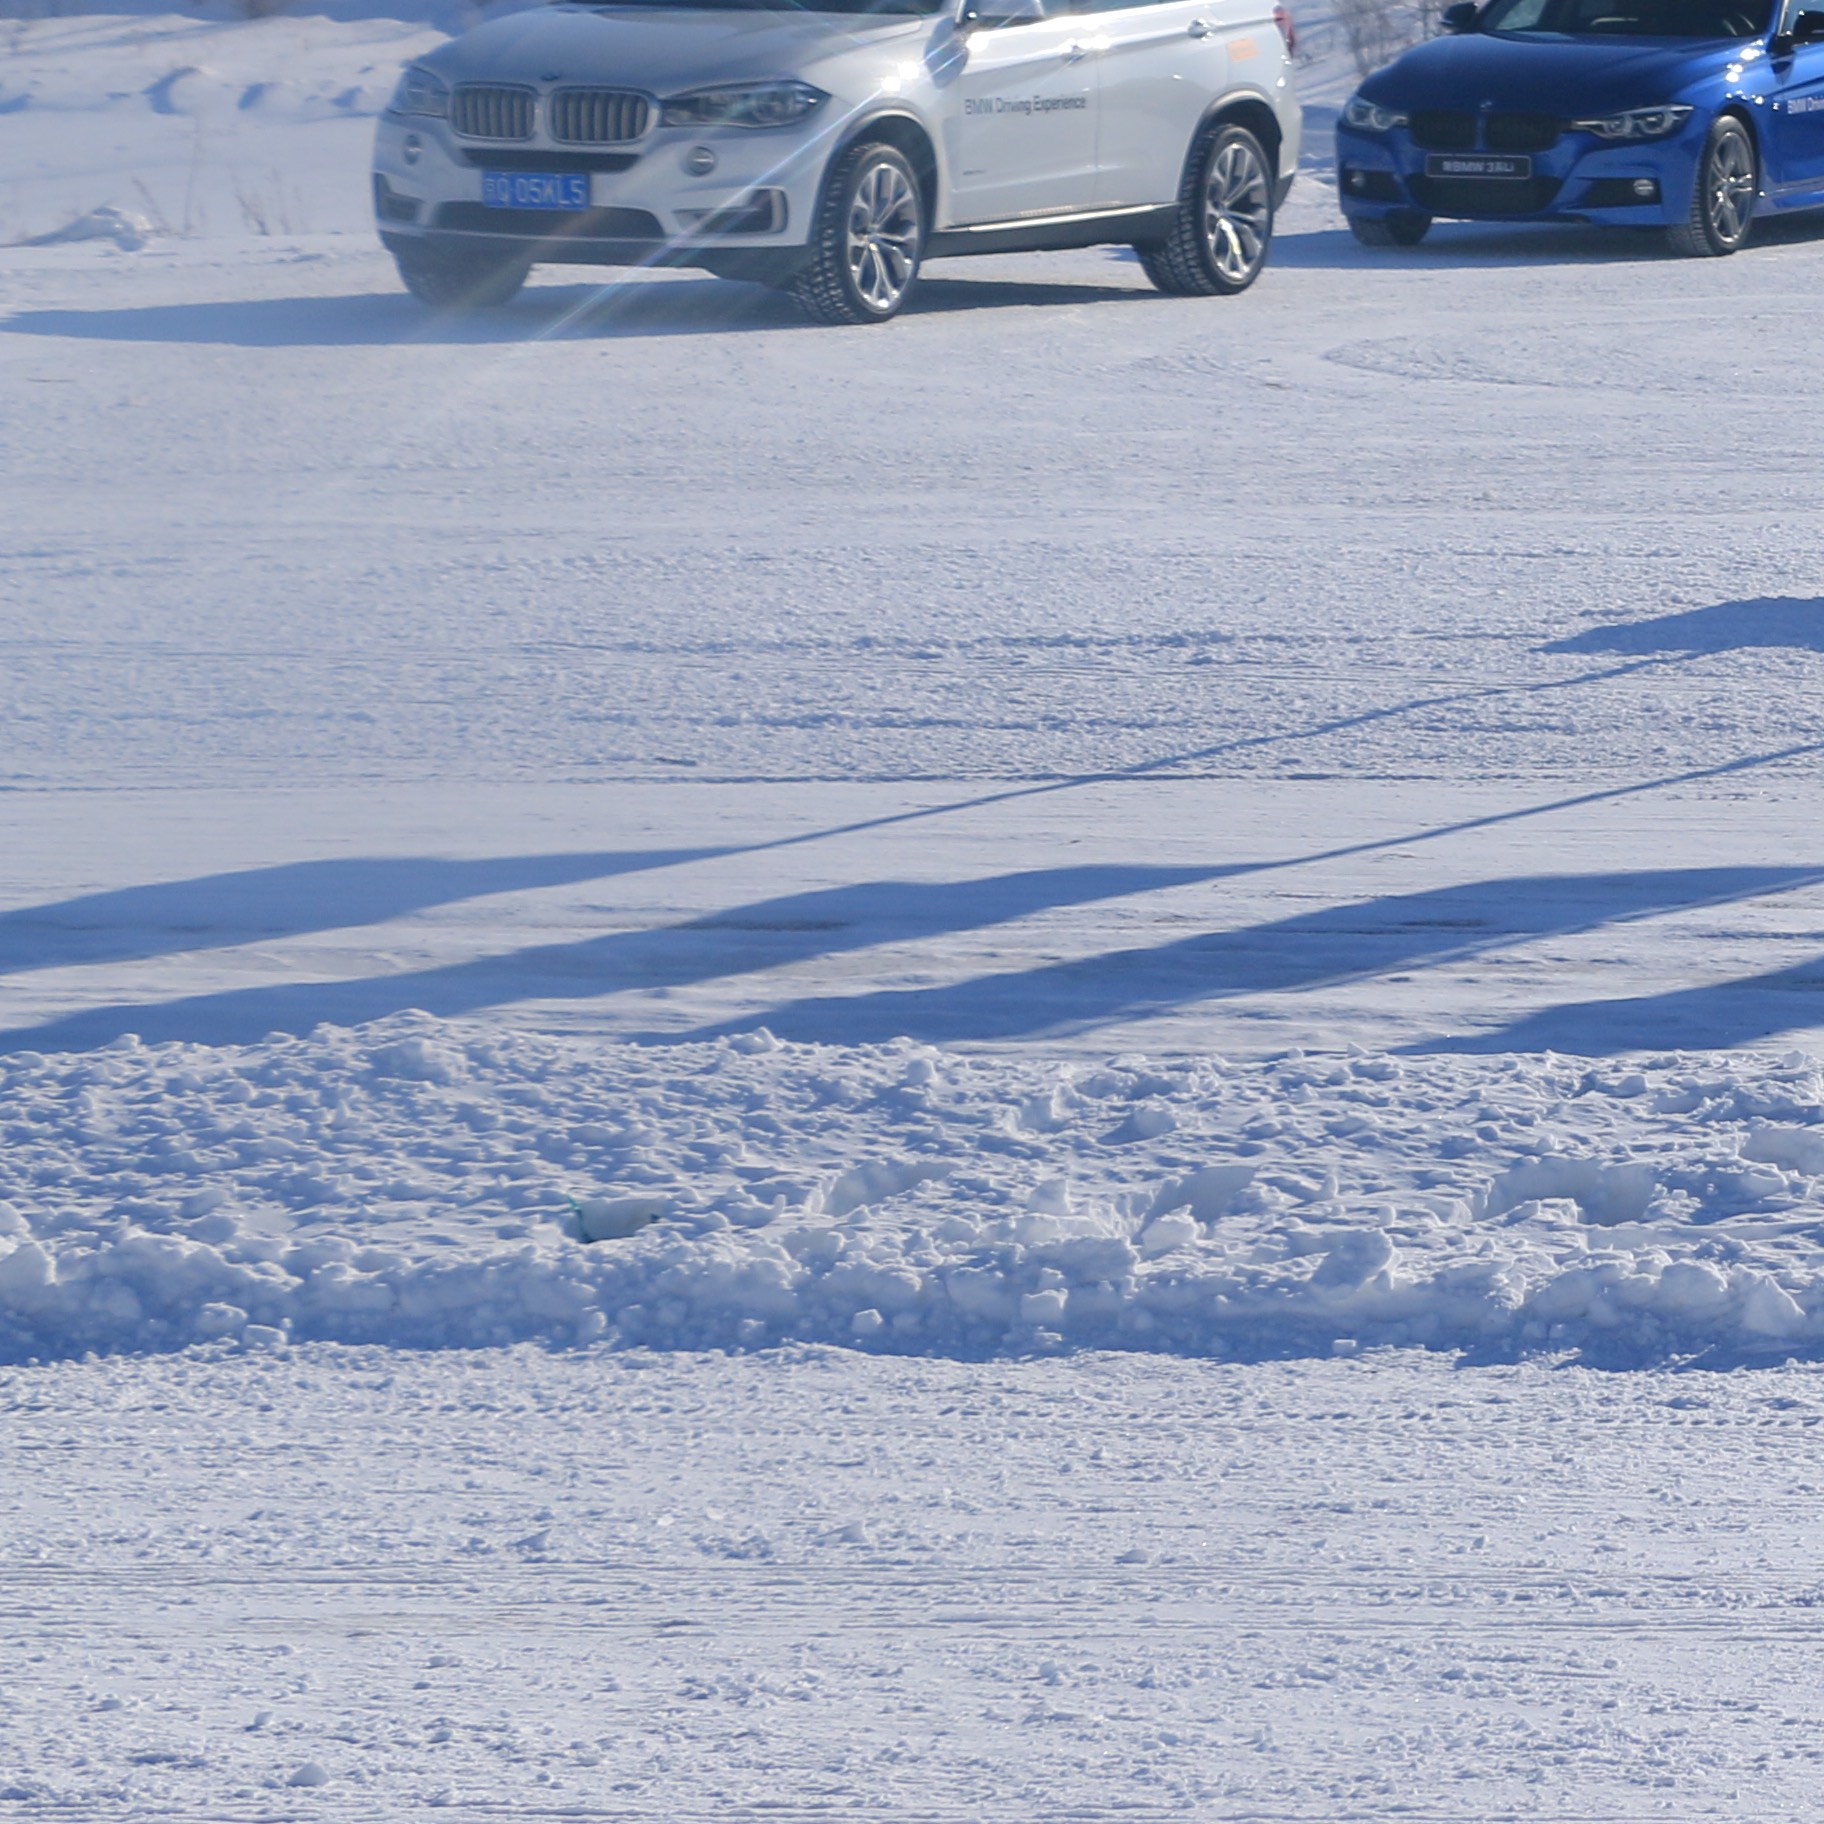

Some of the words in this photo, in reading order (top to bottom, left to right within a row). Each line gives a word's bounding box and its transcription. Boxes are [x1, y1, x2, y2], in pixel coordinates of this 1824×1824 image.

[964, 98, 993, 115] BMW
[995, 96, 1032, 116] Driving
[1032, 94, 1087, 113] Experience
